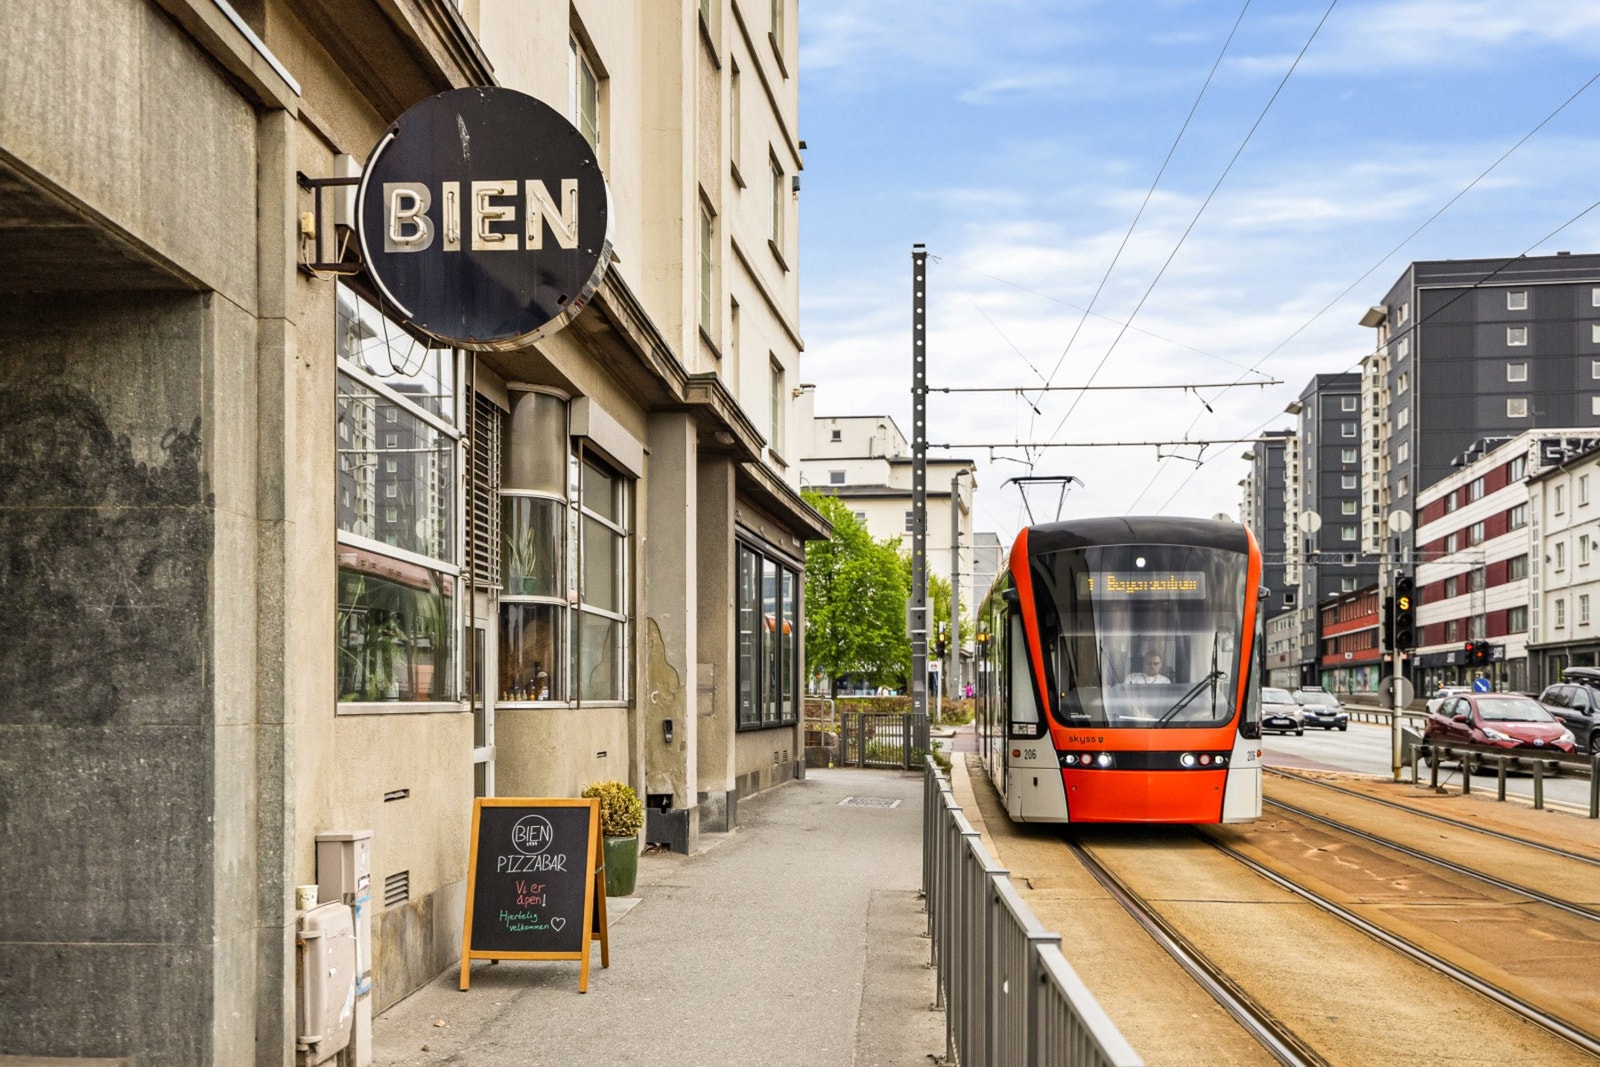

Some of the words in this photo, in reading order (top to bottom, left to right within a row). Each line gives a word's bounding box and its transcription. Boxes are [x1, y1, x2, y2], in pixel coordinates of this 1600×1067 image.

[383, 178, 579, 253] BIEN
[1399, 597, 1409, 610] S
[1068, 734, 1097, 745] skyss
[1024, 749, 1037, 760] 206
[515, 825, 550, 842] BIEN
[497, 854, 567, 874] PIZZABAR
[530, 883, 546, 894] er
[499, 909, 538, 928] Hjertelig
[509, 923, 550, 932] velkommen
